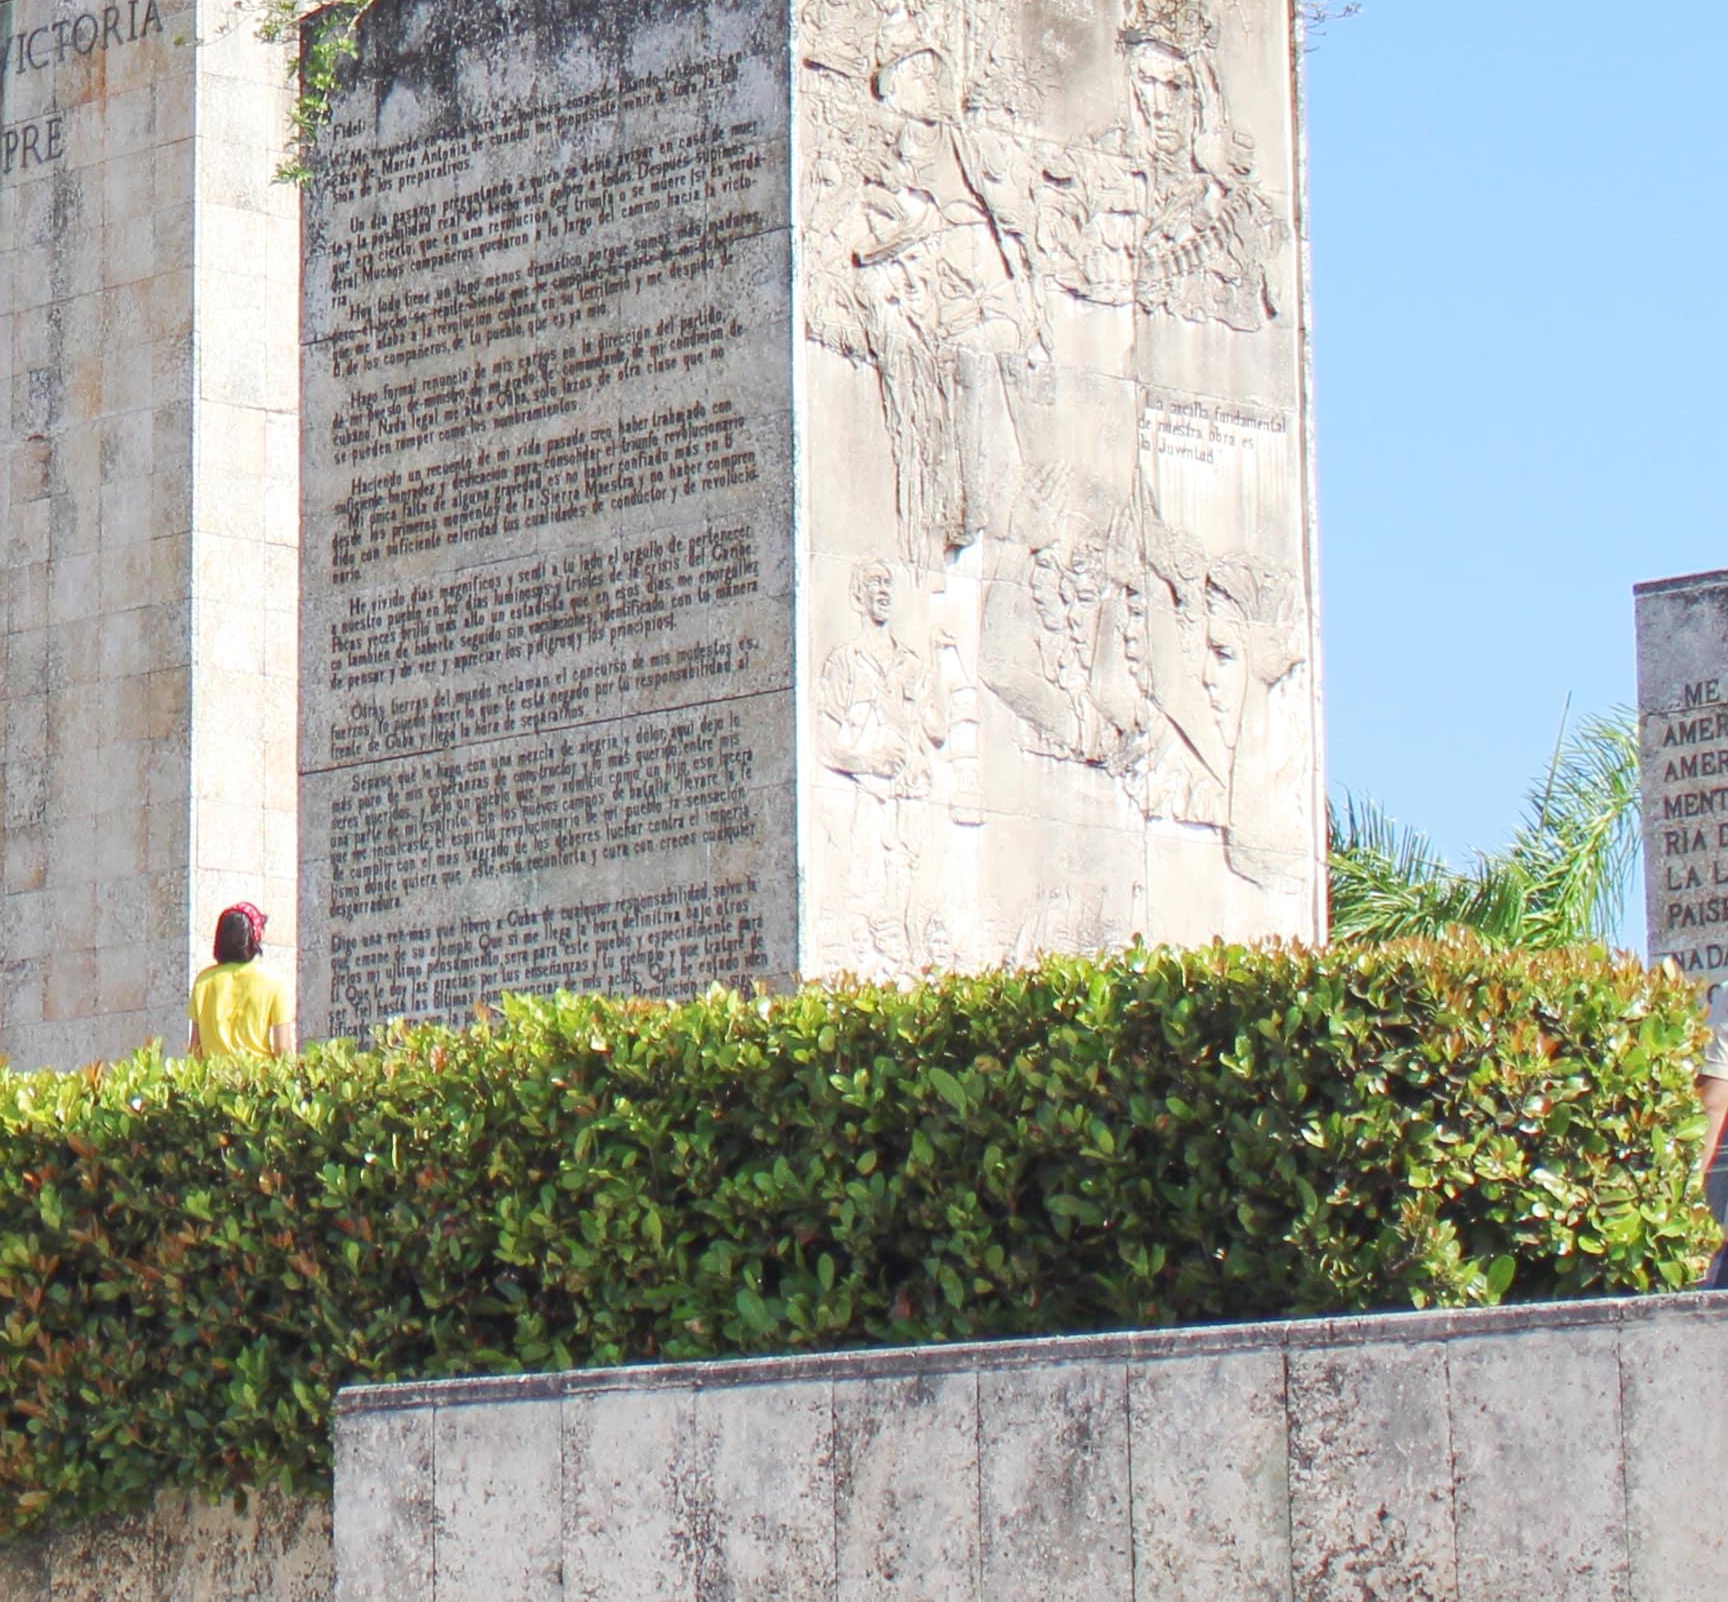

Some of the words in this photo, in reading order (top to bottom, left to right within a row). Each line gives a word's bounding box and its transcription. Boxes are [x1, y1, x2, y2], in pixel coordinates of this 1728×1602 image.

[1138, 413, 1151, 430] de
[1158, 420, 1203, 440] nuestra
[1208, 426, 1236, 447] obra
[1214, 406, 1287, 434] fundamental
[1663, 750, 1728, 784] AMER
[1663, 786, 1728, 820] MENT
[1664, 828, 1708, 857] RIA
[1665, 864, 1702, 892] LA
